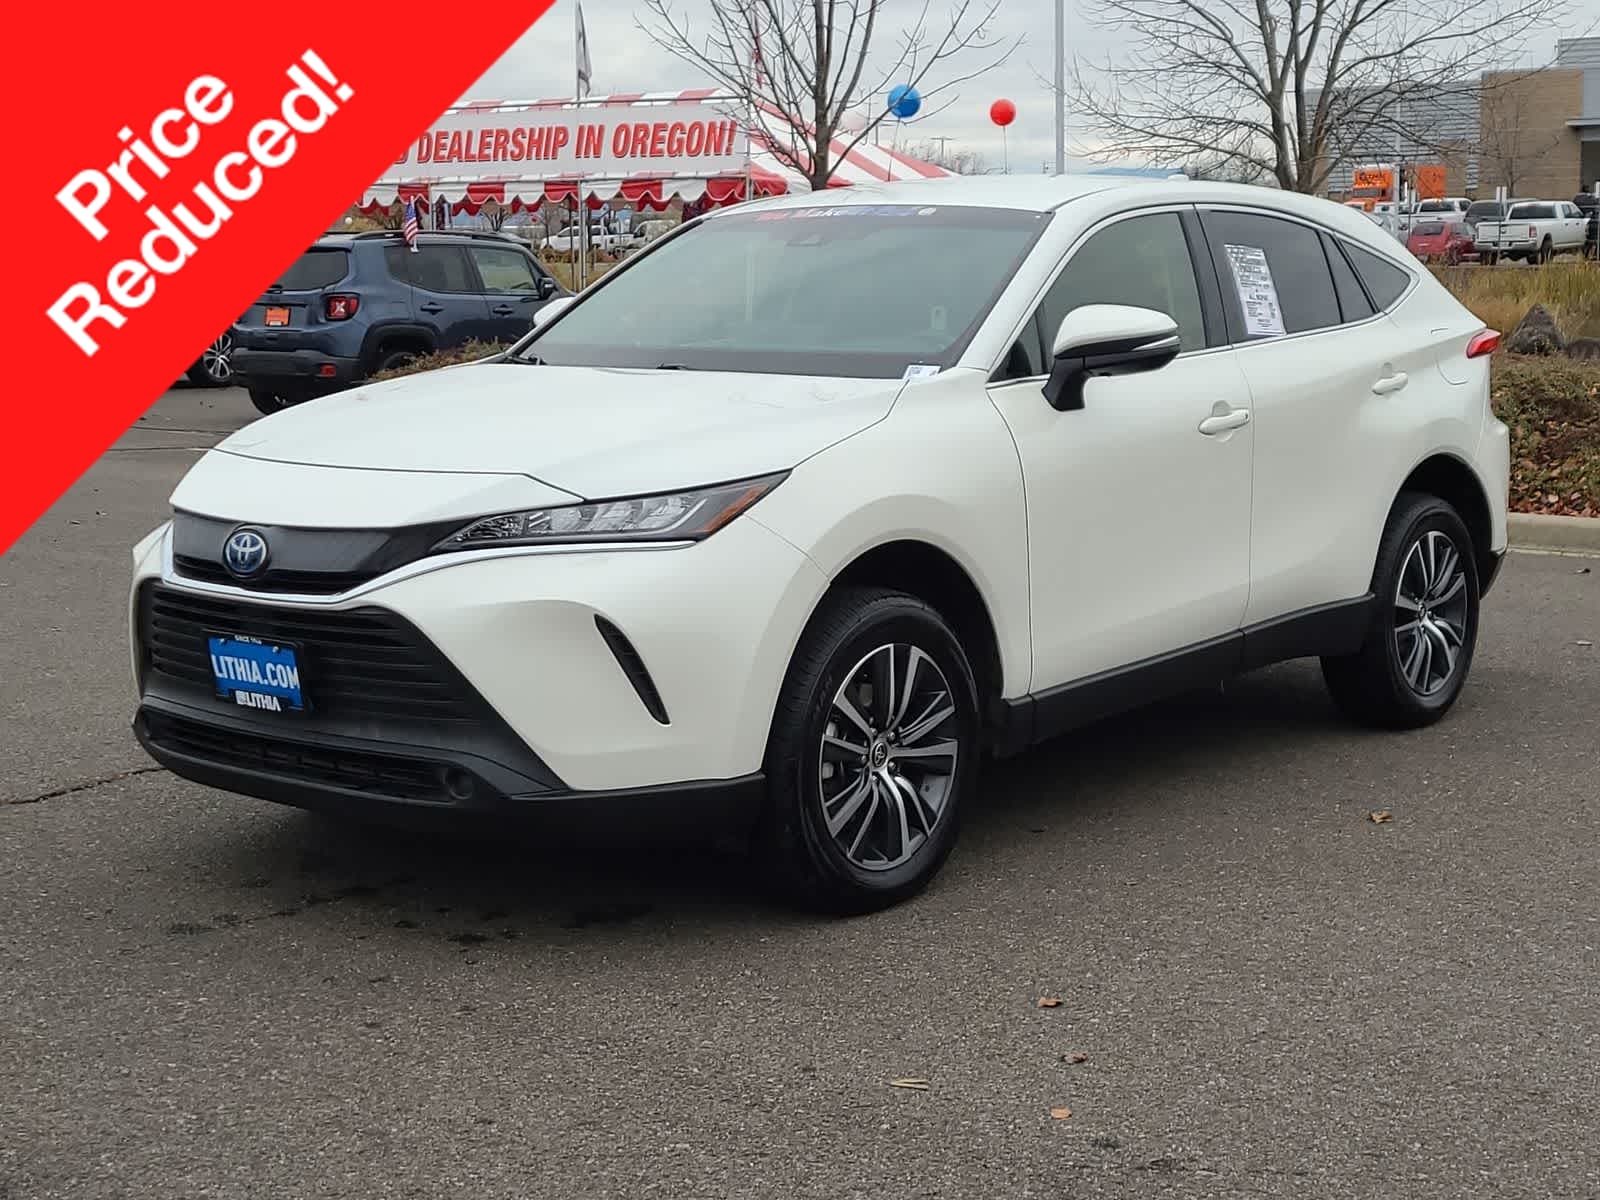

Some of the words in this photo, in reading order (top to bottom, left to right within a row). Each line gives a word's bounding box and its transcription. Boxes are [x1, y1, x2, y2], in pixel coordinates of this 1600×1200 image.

[416, 125, 569, 164] DEALERSHIP
[575, 124, 605, 159] IN
[612, 120, 738, 158] OREGON!
[211, 654, 300, 690] LITHIA.COM
